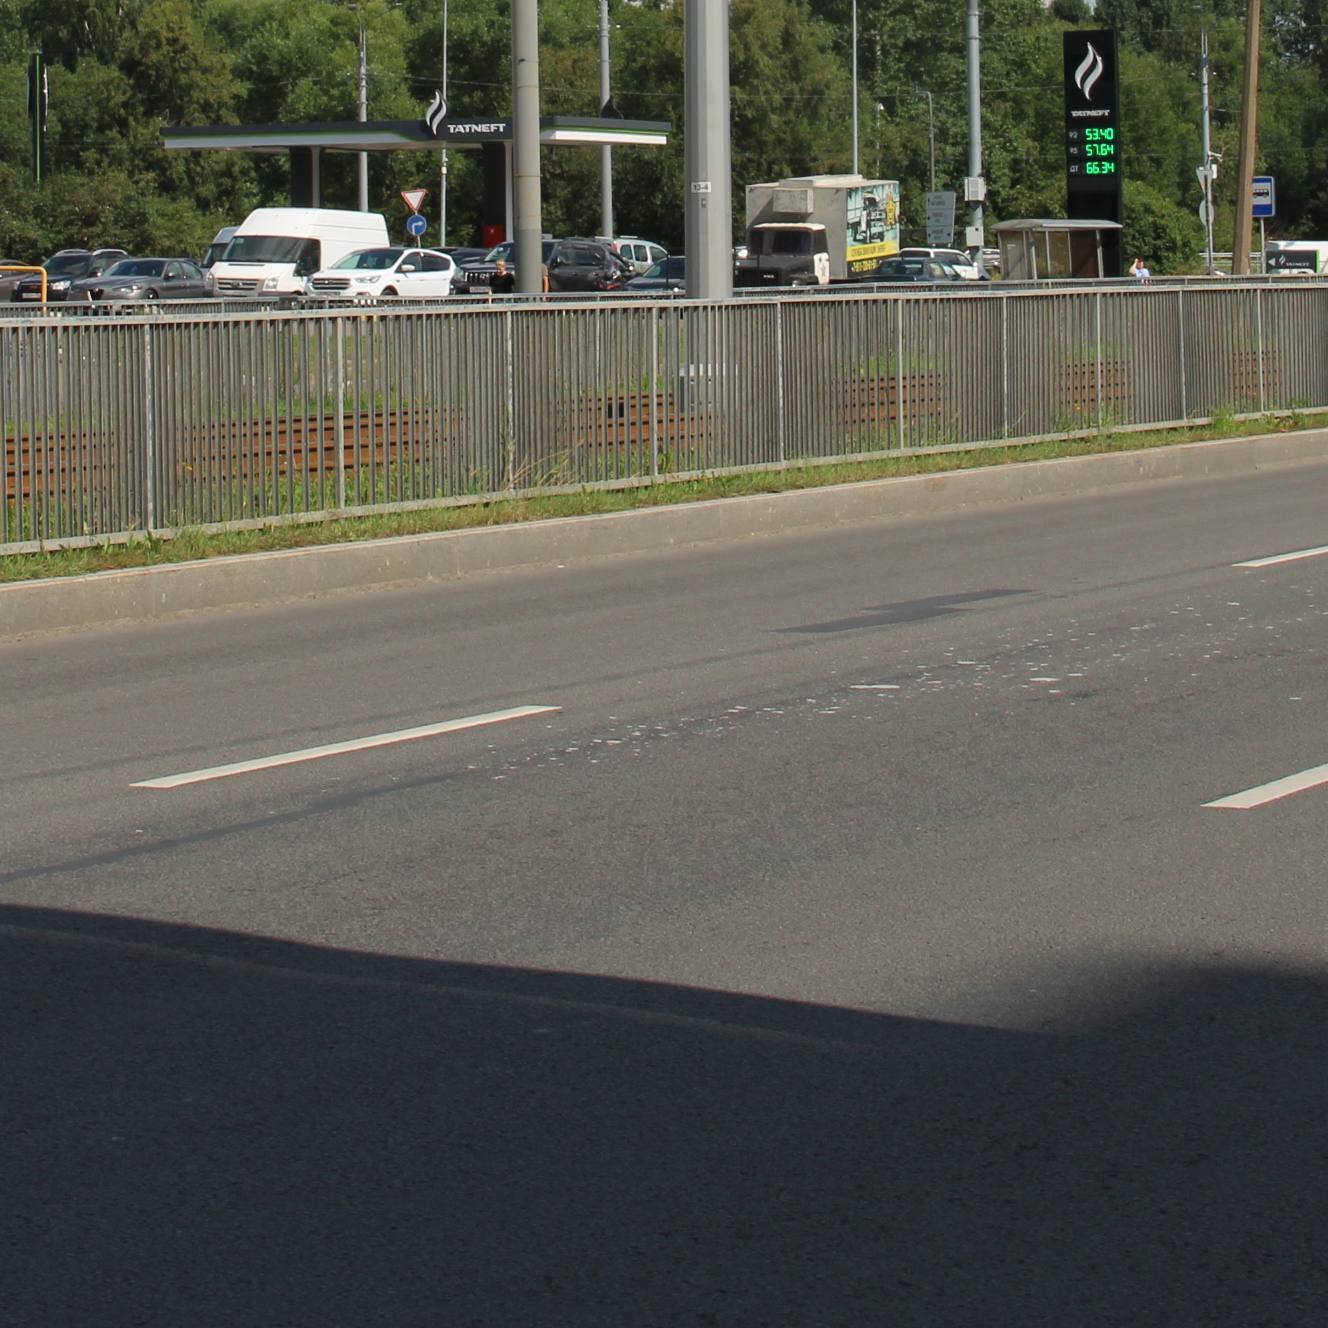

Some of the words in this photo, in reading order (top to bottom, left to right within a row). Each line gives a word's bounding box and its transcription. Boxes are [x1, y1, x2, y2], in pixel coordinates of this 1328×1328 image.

[448, 123, 506, 133] TATNEFT
[1085, 128, 1114, 141] 53.40
[1085, 143, 1114, 156] 57.64
[1086, 162, 1114, 174] 66.34
